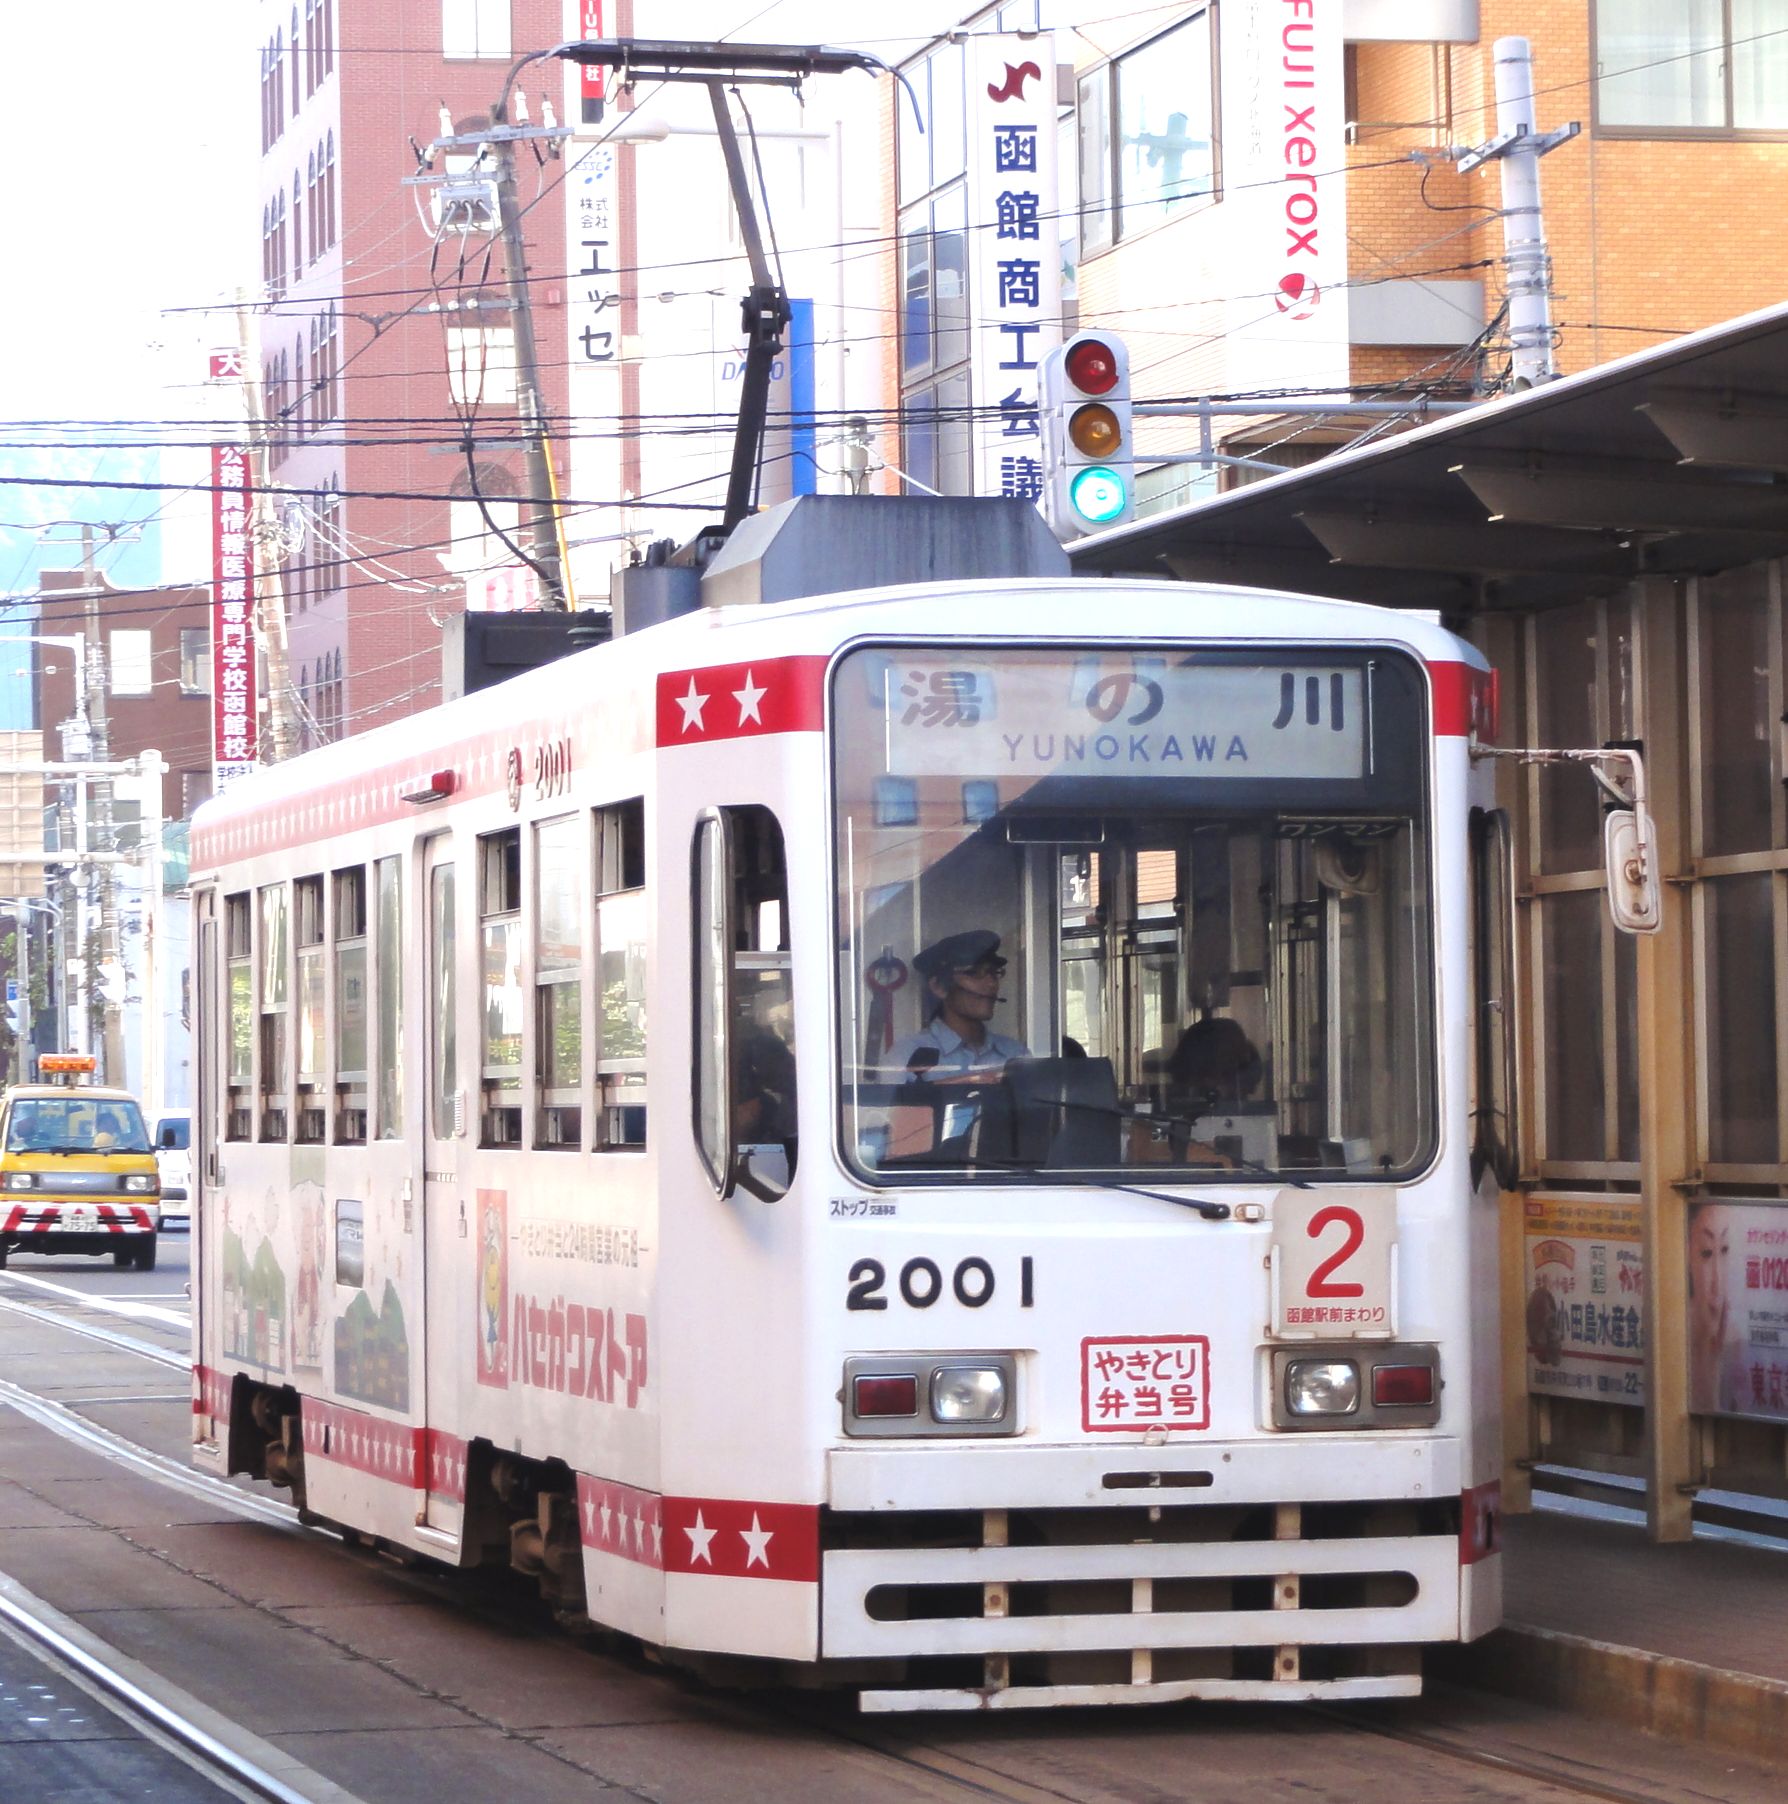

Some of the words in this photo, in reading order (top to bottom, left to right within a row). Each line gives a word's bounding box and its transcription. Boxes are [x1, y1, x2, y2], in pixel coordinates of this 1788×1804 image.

[1282, 0, 1314, 88] FUJI
[1284, 104, 1319, 257] xerox
[579, 240, 614, 360] エッセ
[901, 670, 1344, 732] 湯の川
[535, 737, 572, 802] 2001
[1002, 734, 1249, 763] YUNOKAWA
[1279, 823, 1397, 838] ワンマン
[831, 1199, 868, 1216] ストップ
[1306, 1206, 1364, 1298] 2
[846, 1256, 1034, 1311] 2001
[1286, 1307, 1386, 1324] 函館駅前まわり
[512, 1293, 648, 1409] ハセガワストア
[1094, 1349, 1197, 1382] やきとり
[1096, 1384, 1198, 1418] 弁当号
